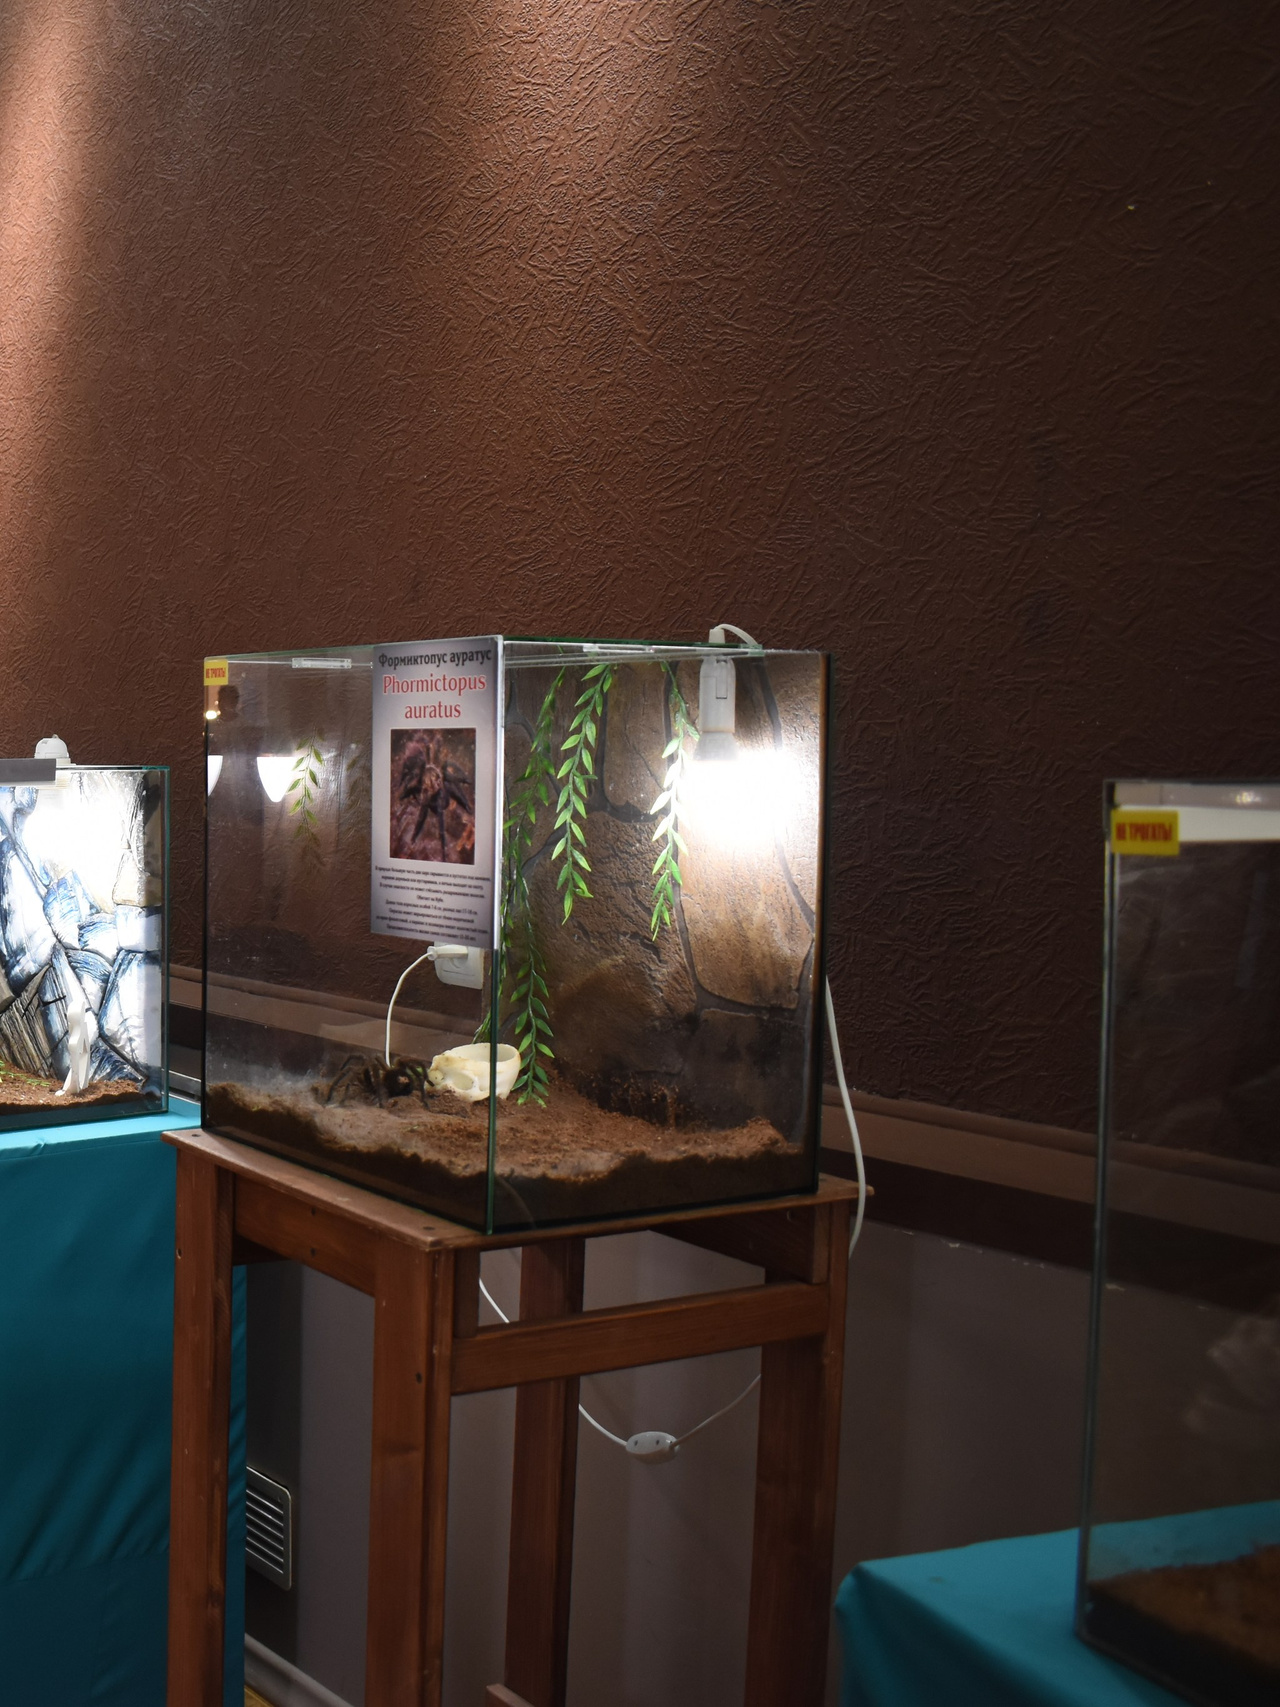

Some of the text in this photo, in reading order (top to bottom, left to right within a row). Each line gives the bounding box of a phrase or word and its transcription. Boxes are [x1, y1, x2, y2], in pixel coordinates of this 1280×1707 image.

[378, 649, 492, 670] Формиктопус ауратус
[383, 673, 487, 696] Phormictopus
[404, 701, 462, 719] auratus
